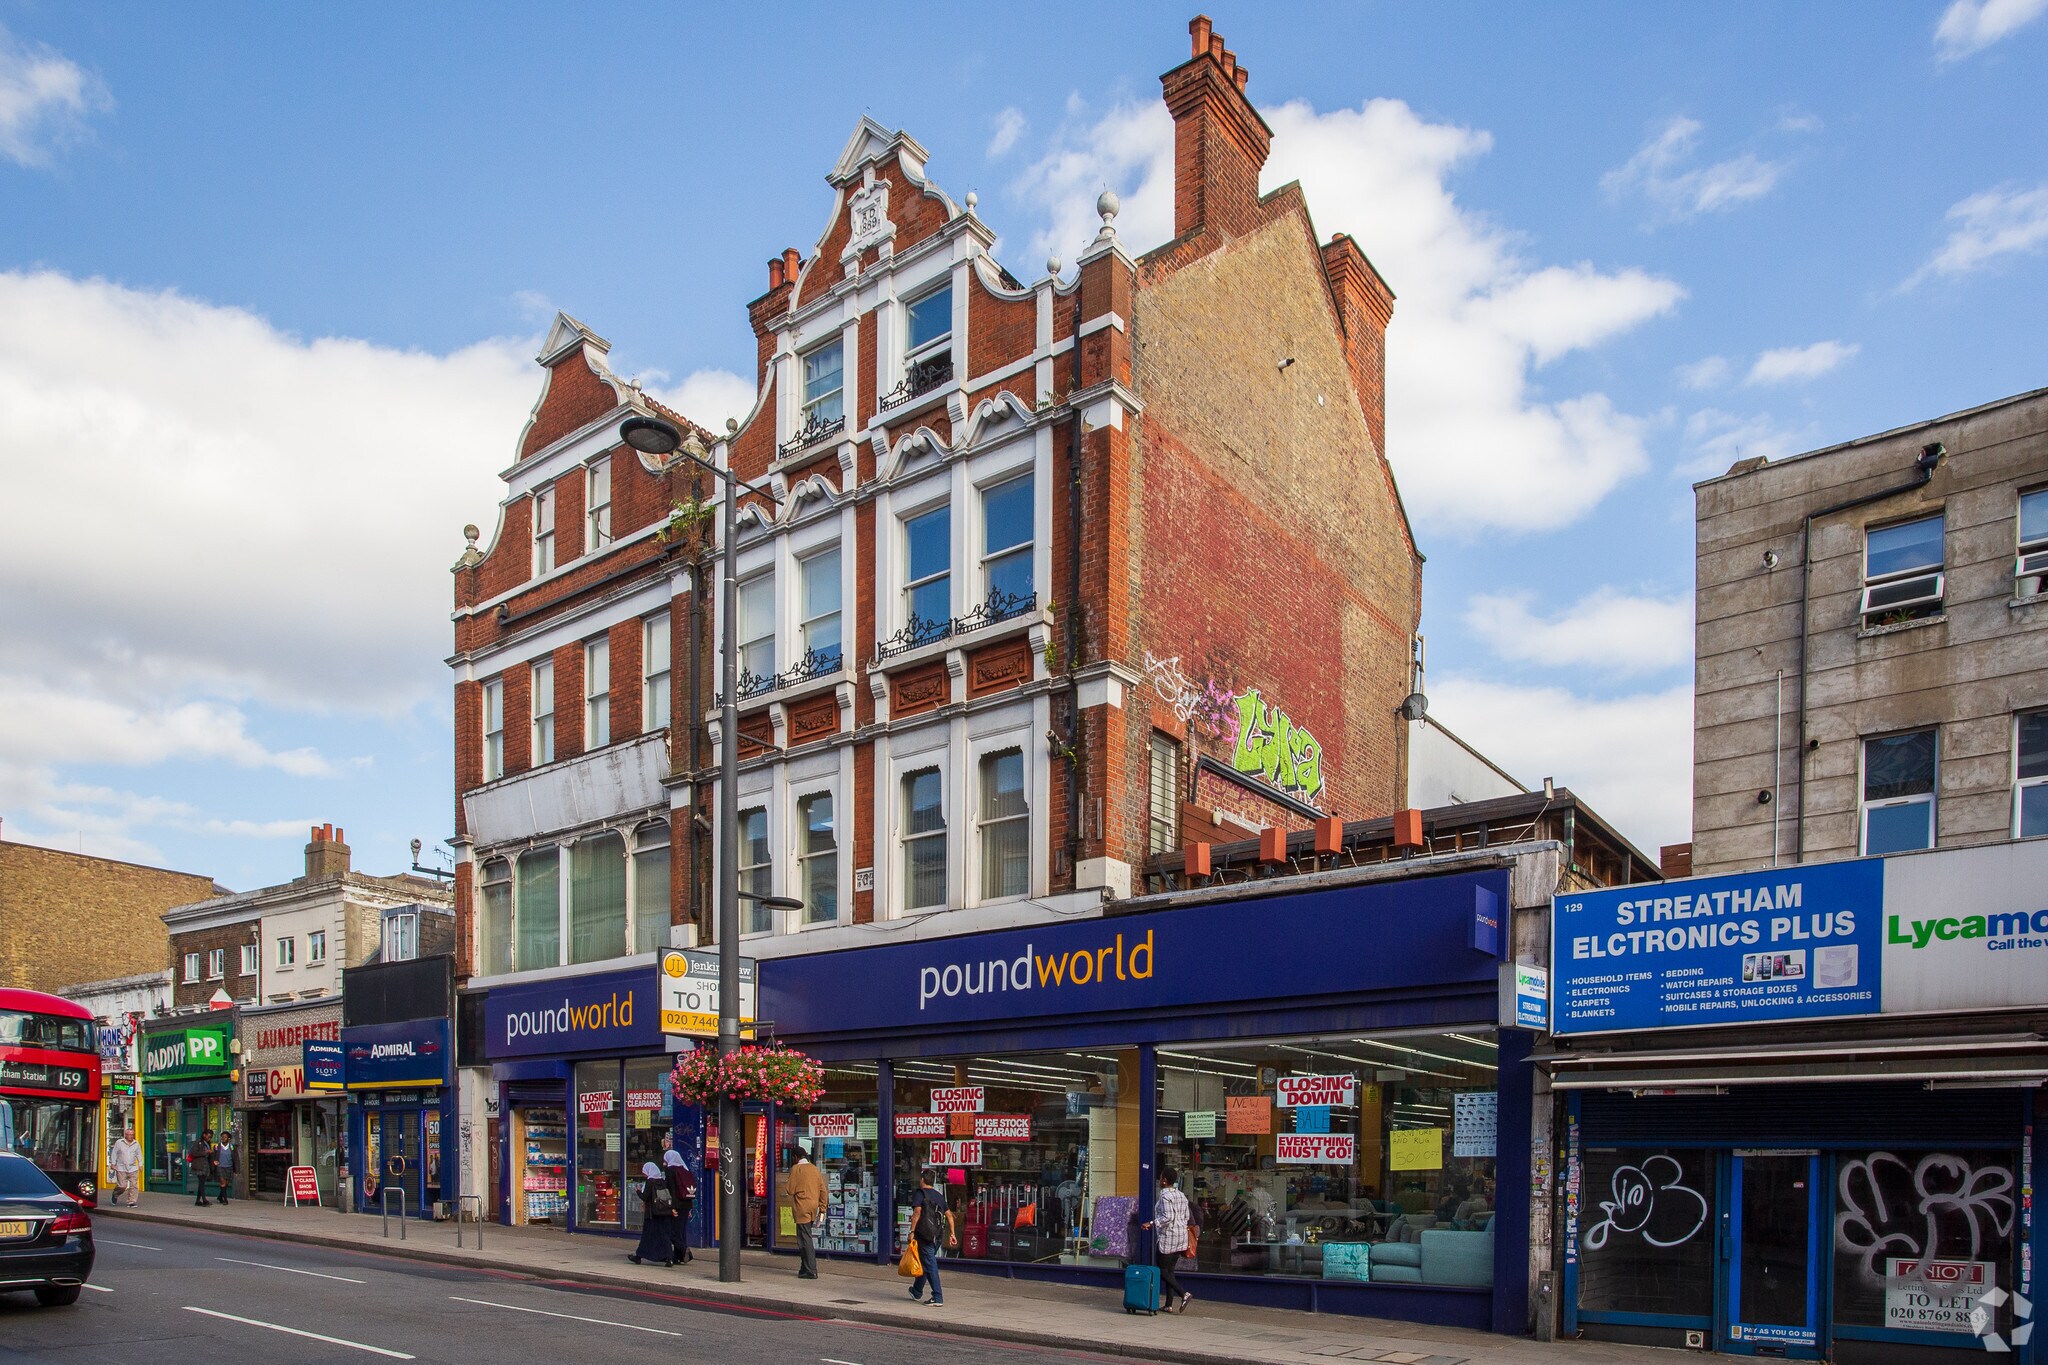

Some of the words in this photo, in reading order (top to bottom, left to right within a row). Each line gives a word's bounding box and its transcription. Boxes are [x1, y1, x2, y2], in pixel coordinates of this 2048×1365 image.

[1564, 903, 1583, 913] 129
[1616, 882, 1803, 925] STREATHAM
[1573, 920, 1759, 960] ELCTRONICS
[1770, 911, 1856, 942] PLUS
[1987, 939, 2015, 950] Call
[2018, 938, 2042, 949] the
[920, 929, 1154, 1010] poundworld
[1666, 968, 1704, 978] BEDDING
[1572, 974, 1624, 985] HOUSEHOLD
[1625, 971, 1653, 981] ITEMS
[1666, 980, 1695, 990] WATCH
[1697, 977, 1734, 987] REPAIRS
[697, 981, 719, 992] SHO
[1572, 985, 1630, 996] ELECTRONICS
[1666, 990, 1712, 1001] SUITCASES
[1722, 987, 1764, 997] STORAGE
[1767, 984, 1798, 994] BOXES
[673, 991, 701, 1010] TO
[1572, 998, 1610, 1007] CARPETS
[1665, 1004, 1698, 1013] MOBILE
[1700, 1001, 1739, 1011] REPAIRS,
[1741, 997, 1794, 1008] UNLOCKING
[1797, 996, 1803, 1004] &
[1806, 991, 1872, 1003] ACCESSORIES
[507, 991, 633, 1045] poundworld
[1571, 1009, 1615, 1018] BLANKETS
[666, 1013, 688, 1025] 020
[692, 1015, 719, 1028] 7440
[257, 1021, 339, 1050] LAUNDERETTE
[309, 1045, 343, 1054] ADMIRAL
[371, 1041, 416, 1059] ADMIRAL
[309, 1060, 342, 1069] CASINO
[0, 1069, 21, 1079] atham
[22, 1070, 47, 1081] Station
[59, 1072, 81, 1087] 159
[249, 1074, 267, 1083] WASH
[270, 1070, 292, 1095] Coin
[1278, 1076, 1353, 1092] CLOSING
[255, 1085, 267, 1094] DRY
[932, 1088, 983, 1101] CLOSING
[580, 1092, 612, 1103] CLOSING
[1232, 1097, 1260, 1109] NEW
[1287, 1091, 1343, 1105] DOWN
[584, 1101, 609, 1111] DOWN
[938, 1100, 977, 1112] DOWN
[809, 1115, 853, 1126] CLOSING
[896, 1117, 918, 1125] HUGE
[918, 1116, 945, 1125] STOCK
[975, 1118, 999, 1128] HUGE
[999, 1118, 1029, 1128] STOCK
[1297, 1110, 1330, 1129] SALE
[429, 1121, 440, 1134] 50
[814, 1126, 848, 1136] DOWN
[896, 1125, 945, 1134] CLEARANCE
[975, 1127, 1029, 1137] CLEARANCE
[1278, 1136, 1353, 1146] EVERYTHING
[931, 1142, 957, 1164] 50%
[960, 1141, 980, 1164] OFF
[1278, 1147, 1321, 1159] MUST
[1325, 1146, 1352, 1159] GO!
[1897, 1284, 1929, 1294] Letting
[1967, 1286, 1983, 1295] Ltd
[1906, 1293, 1931, 1306] TO
[1938, 1296, 1973, 1309] LET
[1890, 1307, 1914, 1319] 020
[1918, 1309, 1951, 1322] 8769
[1955, 1311, 1990, 1324] 8839
